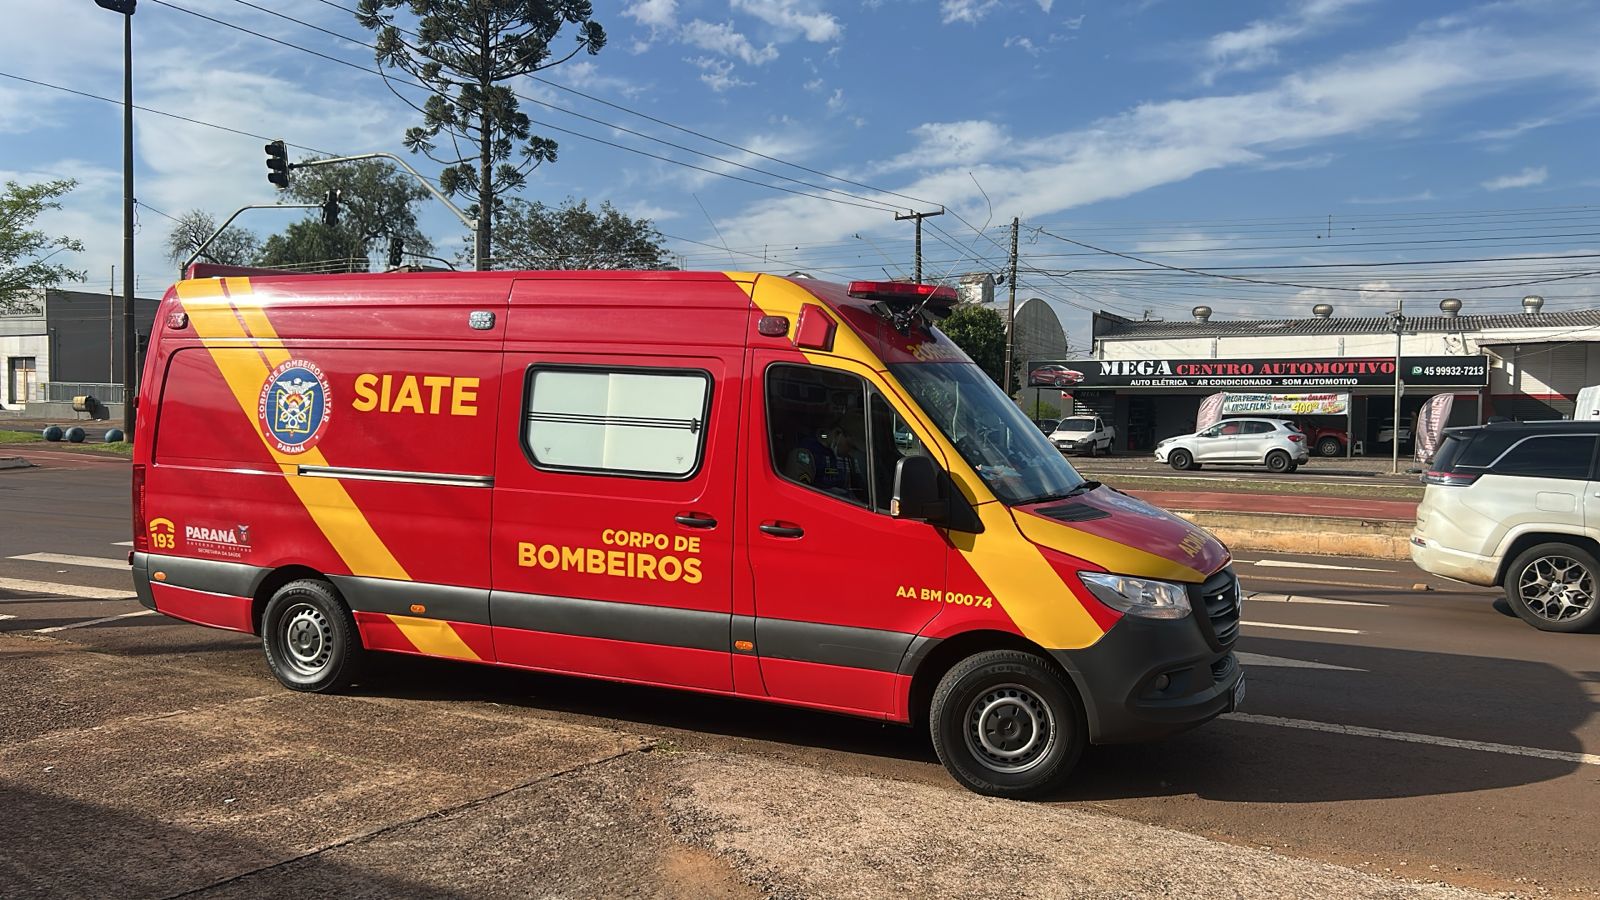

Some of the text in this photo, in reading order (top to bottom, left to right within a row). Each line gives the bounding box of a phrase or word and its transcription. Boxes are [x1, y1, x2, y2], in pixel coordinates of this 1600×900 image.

[1099, 360, 1395, 376] MEGA CENTRO AUTOMOTIVO
[1423, 366, 1484, 376] 45 99932-7213
[259, 359, 332, 422] CORPO DE BOMBEIROS MILITAR
[1152, 378, 1188, 386] ELÉTRICA
[1282, 378, 1301, 386] SOM
[352, 373, 480, 416] SIATE
[276, 443, 305, 453] PARANÁ
[151, 532, 175, 549] 193
[185, 526, 237, 543] PARANÁ
[602, 528, 701, 553] CORPO DE
[518, 541, 703, 584] BOMBEIROS
[896, 585, 993, 609] AA BM 00074
